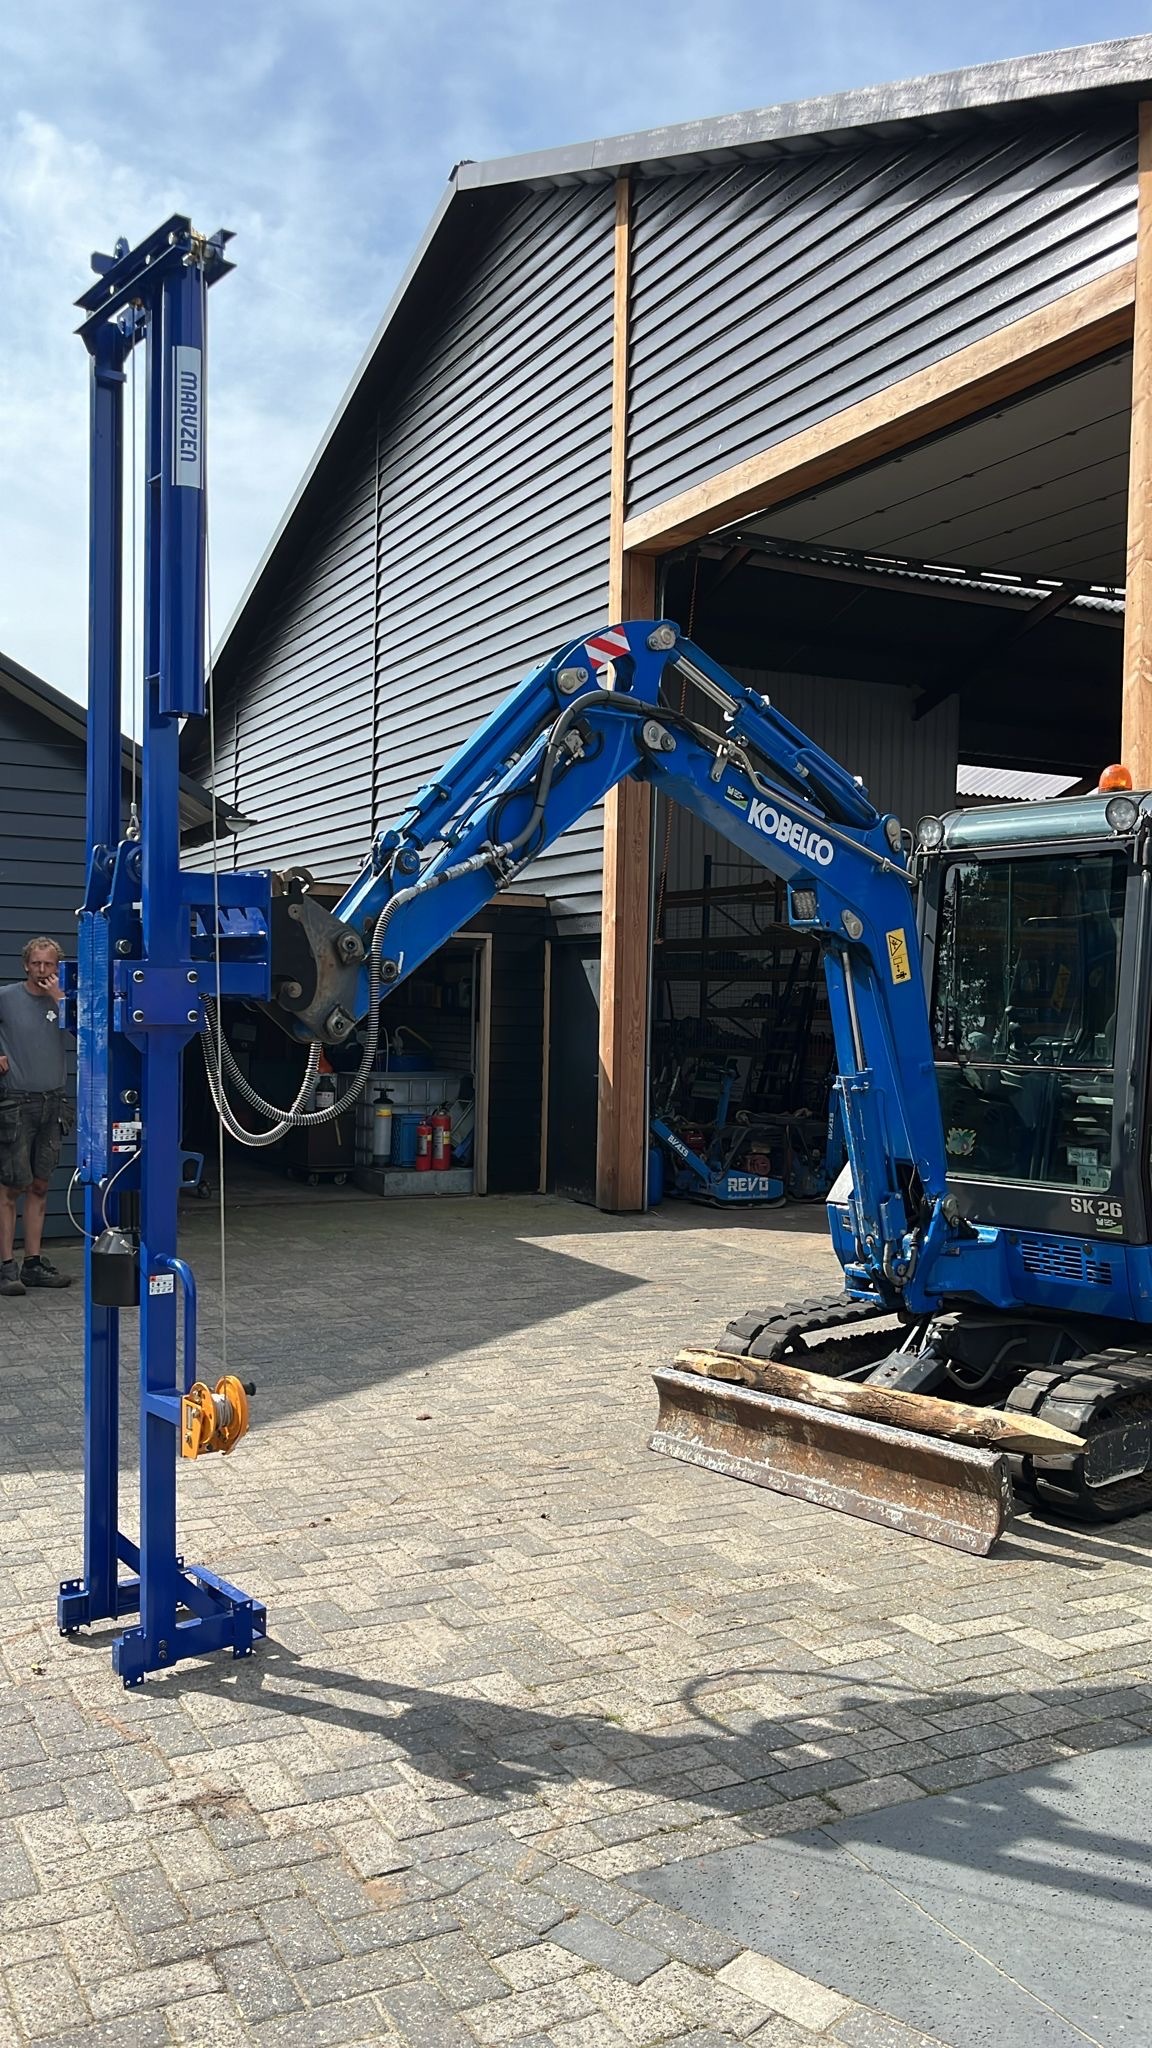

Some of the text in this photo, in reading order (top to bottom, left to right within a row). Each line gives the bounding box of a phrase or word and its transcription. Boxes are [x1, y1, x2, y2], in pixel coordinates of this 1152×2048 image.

[181, 370, 198, 462] MARUZEN
[747, 797, 834, 865] KOBELCO
[727, 1177, 769, 1192] REVO
[1070, 1197, 1122, 1217] SK 26
